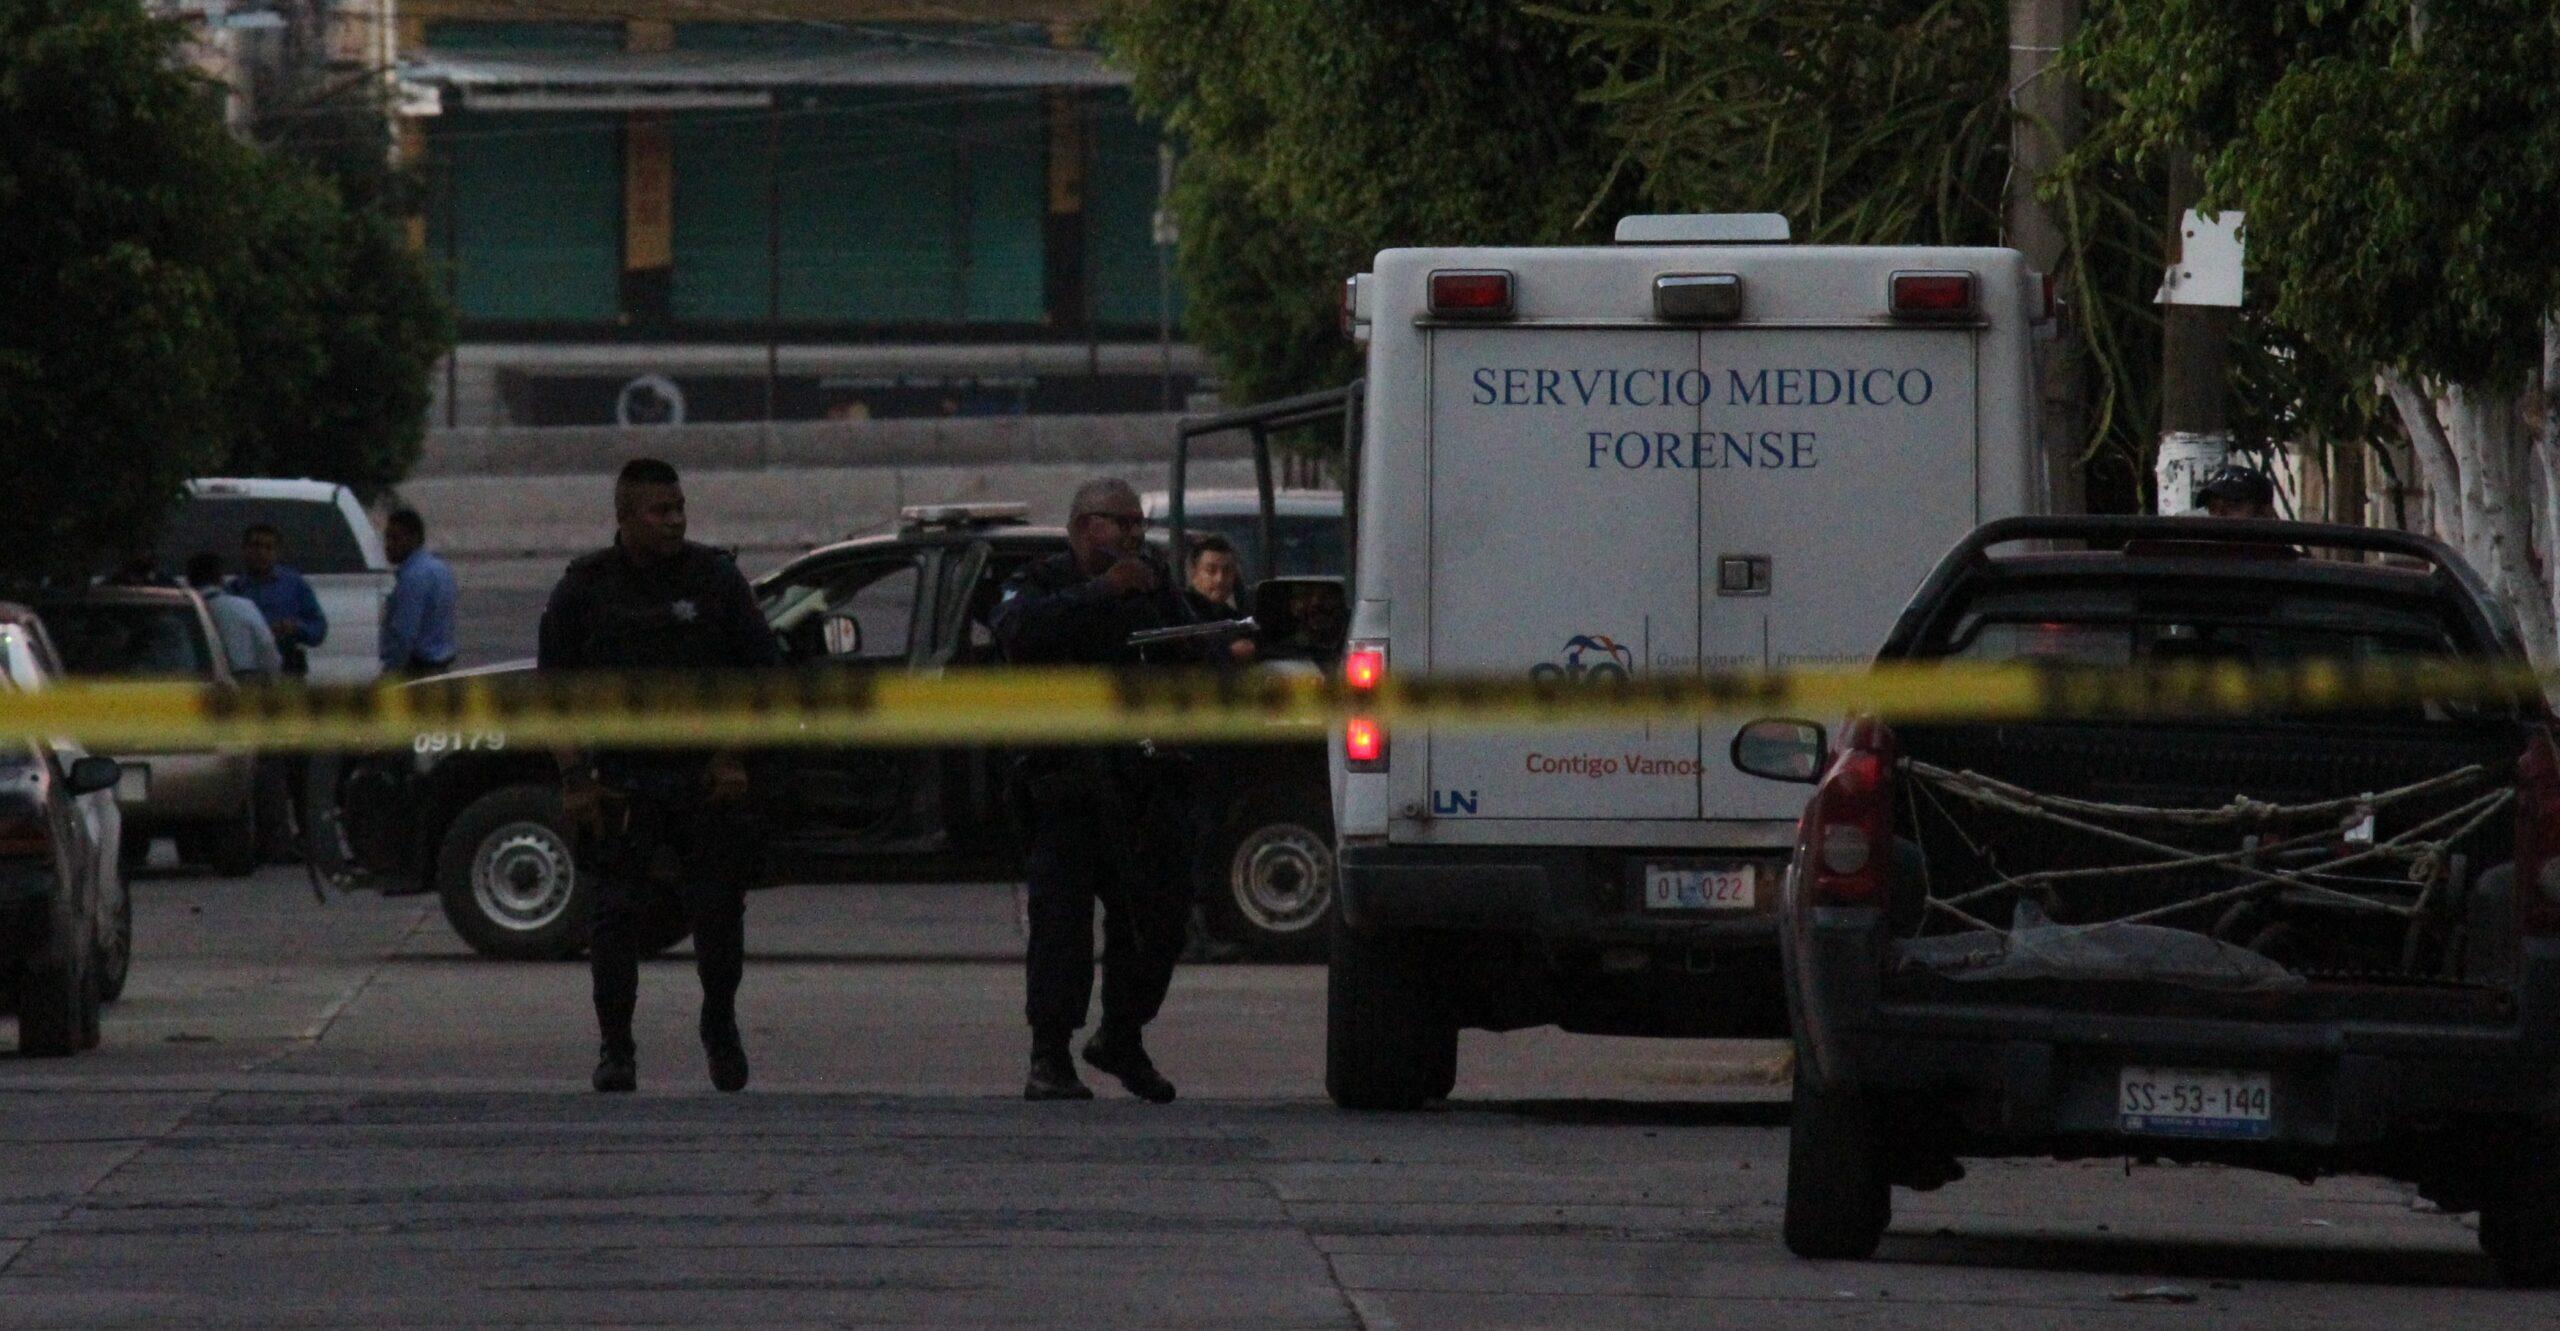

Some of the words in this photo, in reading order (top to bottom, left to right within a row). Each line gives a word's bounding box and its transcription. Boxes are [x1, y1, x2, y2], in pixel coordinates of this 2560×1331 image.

[1472, 367, 1711, 406] SERVICIO
[1728, 367, 1933, 406] MEDICO
[1586, 431, 1818, 469] FORENSE
[1525, 753, 1618, 778] Contigo
[1625, 754, 1704, 775] Vamos
[2126, 1081, 2267, 1116] SS-53-144
